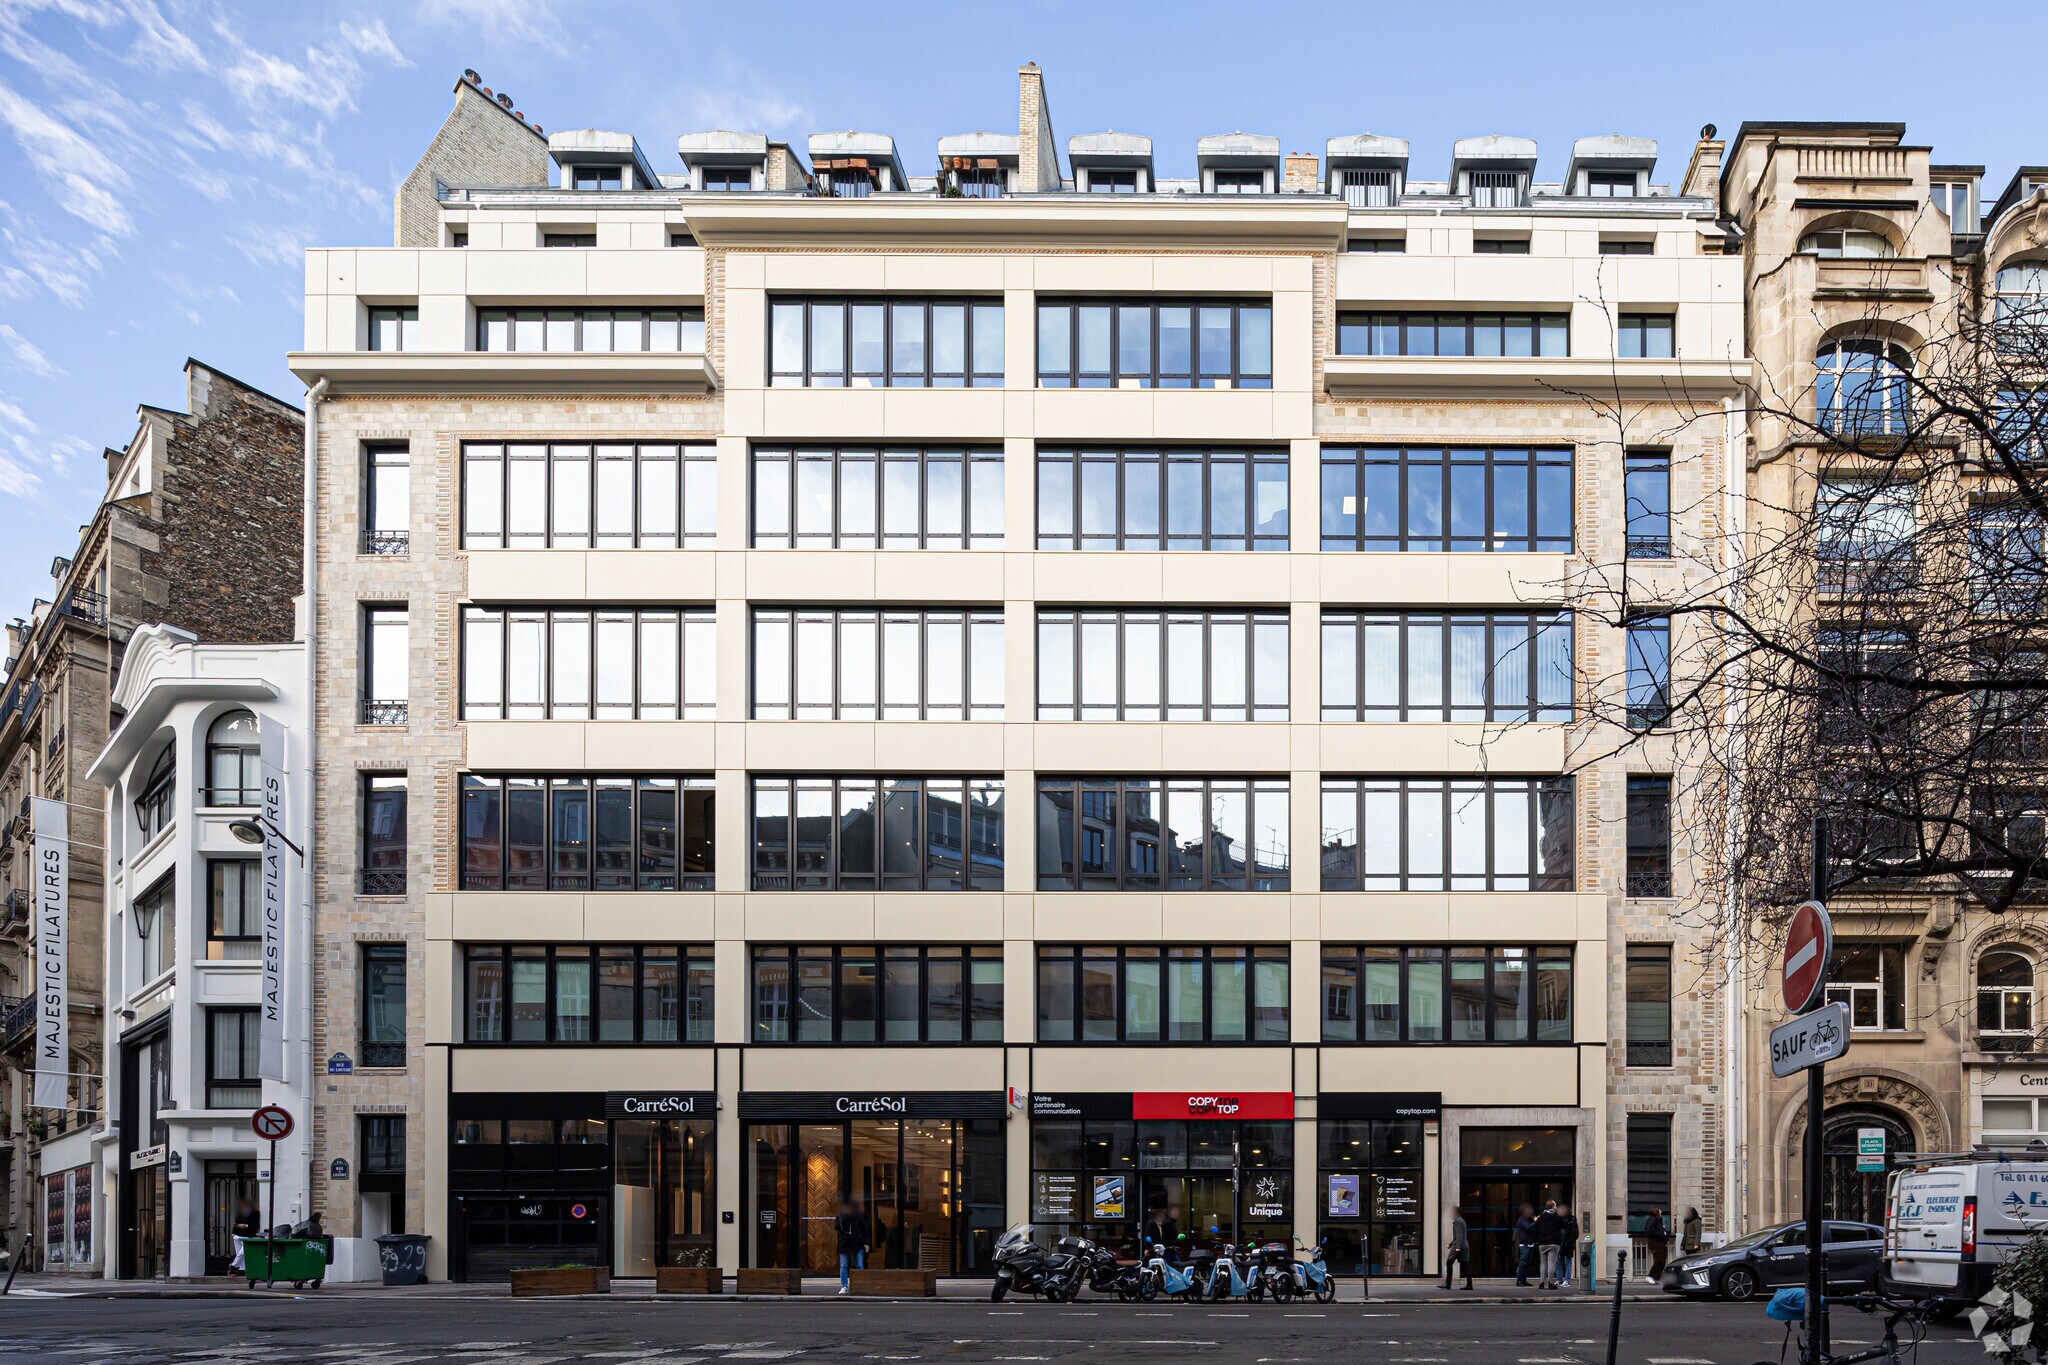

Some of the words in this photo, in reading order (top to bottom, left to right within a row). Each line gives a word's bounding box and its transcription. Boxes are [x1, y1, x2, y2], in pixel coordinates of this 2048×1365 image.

[266, 777, 279, 902] FILATURES
[44, 849, 60, 956] FILATURES
[45, 961, 61, 1058] MAJESTIC
[266, 907, 279, 1021] MAJESTIC
[1773, 1031, 1808, 1062] SAUF
[1249, 1207, 1283, 1217] Unique
[2017, 1174, 2026, 1182] 01
